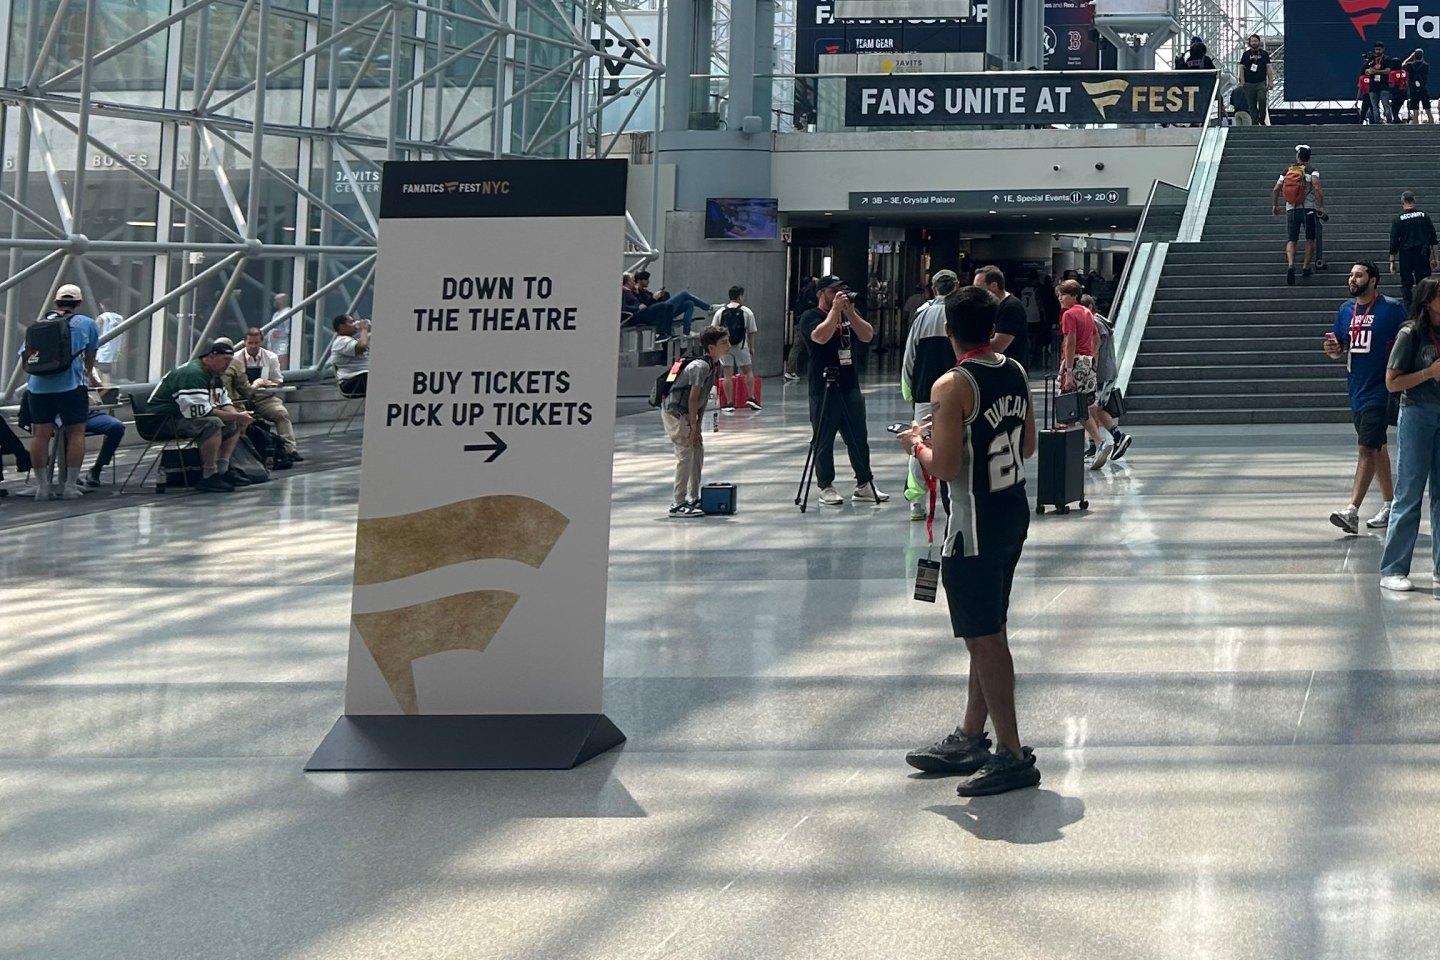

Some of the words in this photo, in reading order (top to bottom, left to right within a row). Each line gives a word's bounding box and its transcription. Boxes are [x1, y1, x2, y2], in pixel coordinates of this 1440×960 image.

[855, 38, 875, 49] TEAM
[875, 38, 894, 49] GEAR
[1067, 30, 1082, 51] B
[896, 59, 923, 67] JAVITS
[861, 87, 935, 115] FANS
[944, 87, 1027, 114] UNITE
[1035, 86, 1072, 113] AT
[1131, 86, 1200, 113] FEST
[402, 182, 445, 194] FANATICS
[458, 182, 481, 193] FEST
[482, 180, 510, 195] NYC
[1095, 193, 1106, 201] 2D
[903, 196, 929, 206] Crystal
[930, 196, 955, 204] Palace
[1016, 194, 1043, 205] Special
[1045, 193, 1070, 202] Events
[442, 276, 514, 300] DOWN
[523, 276, 553, 300] TO
[413, 308, 459, 332] THE
[469, 307, 578, 331] THEATRE
[412, 371, 463, 395] BUY
[471, 370, 571, 394] TICKETS
[386, 402, 443, 427] PICK
[452, 402, 485, 426] UP
[493, 401, 593, 426] TICKETS
[984, 395, 1028, 429] DUNCAN
[987, 424, 1026, 493] 21
